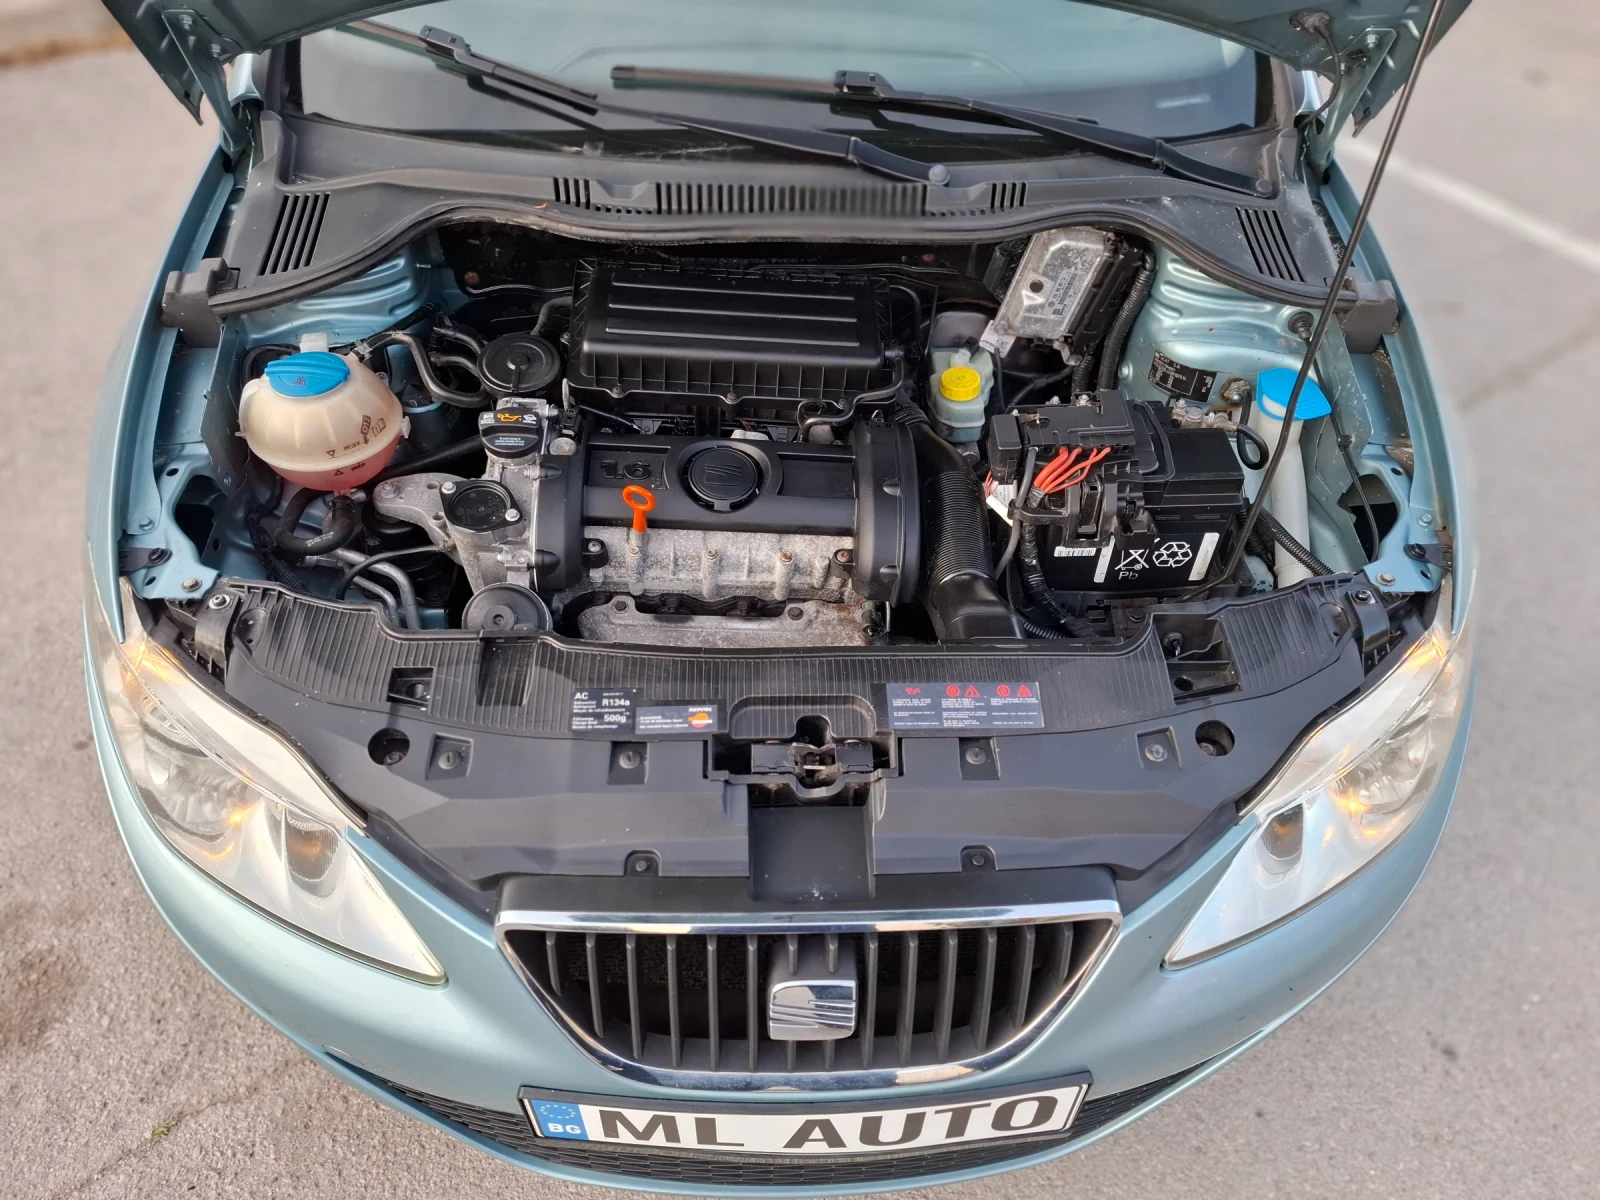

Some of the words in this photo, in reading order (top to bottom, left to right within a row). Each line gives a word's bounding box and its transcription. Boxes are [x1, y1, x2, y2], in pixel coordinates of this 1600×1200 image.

[343, 440, 361, 451] max
[350, 460, 366, 472] min
[600, 460, 651, 480] 1.6
[1118, 571, 1139, 580] Pb
[574, 691, 589, 700] AC
[602, 698, 630, 707] R134a
[604, 714, 627, 723] 500g
[598, 1109, 745, 1147] ML
[782, 1095, 1059, 1149] AUTO
[547, 1122, 582, 1134] BG
